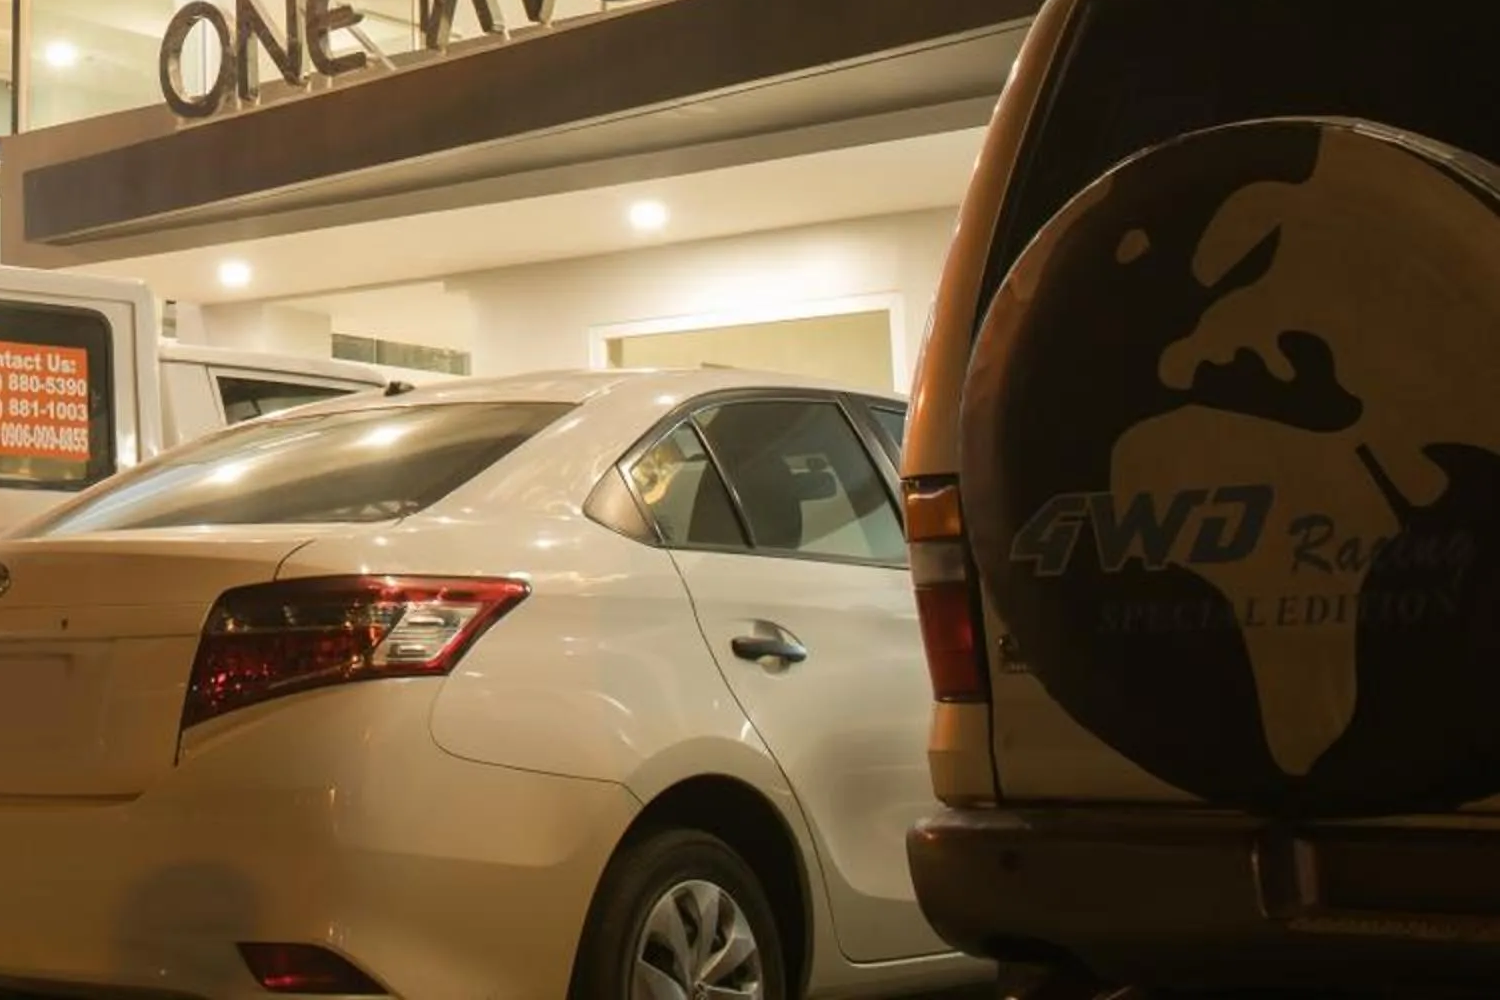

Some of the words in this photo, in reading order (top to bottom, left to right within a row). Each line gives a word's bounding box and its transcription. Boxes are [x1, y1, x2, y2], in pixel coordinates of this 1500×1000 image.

[47, 354, 77, 374] Us:
[8, 374, 88, 397] 880-5390
[8, 399, 88, 422] 881-1003
[1010, 483, 1277, 577] 4WD
[1100, 595, 1267, 632] SPECIL
